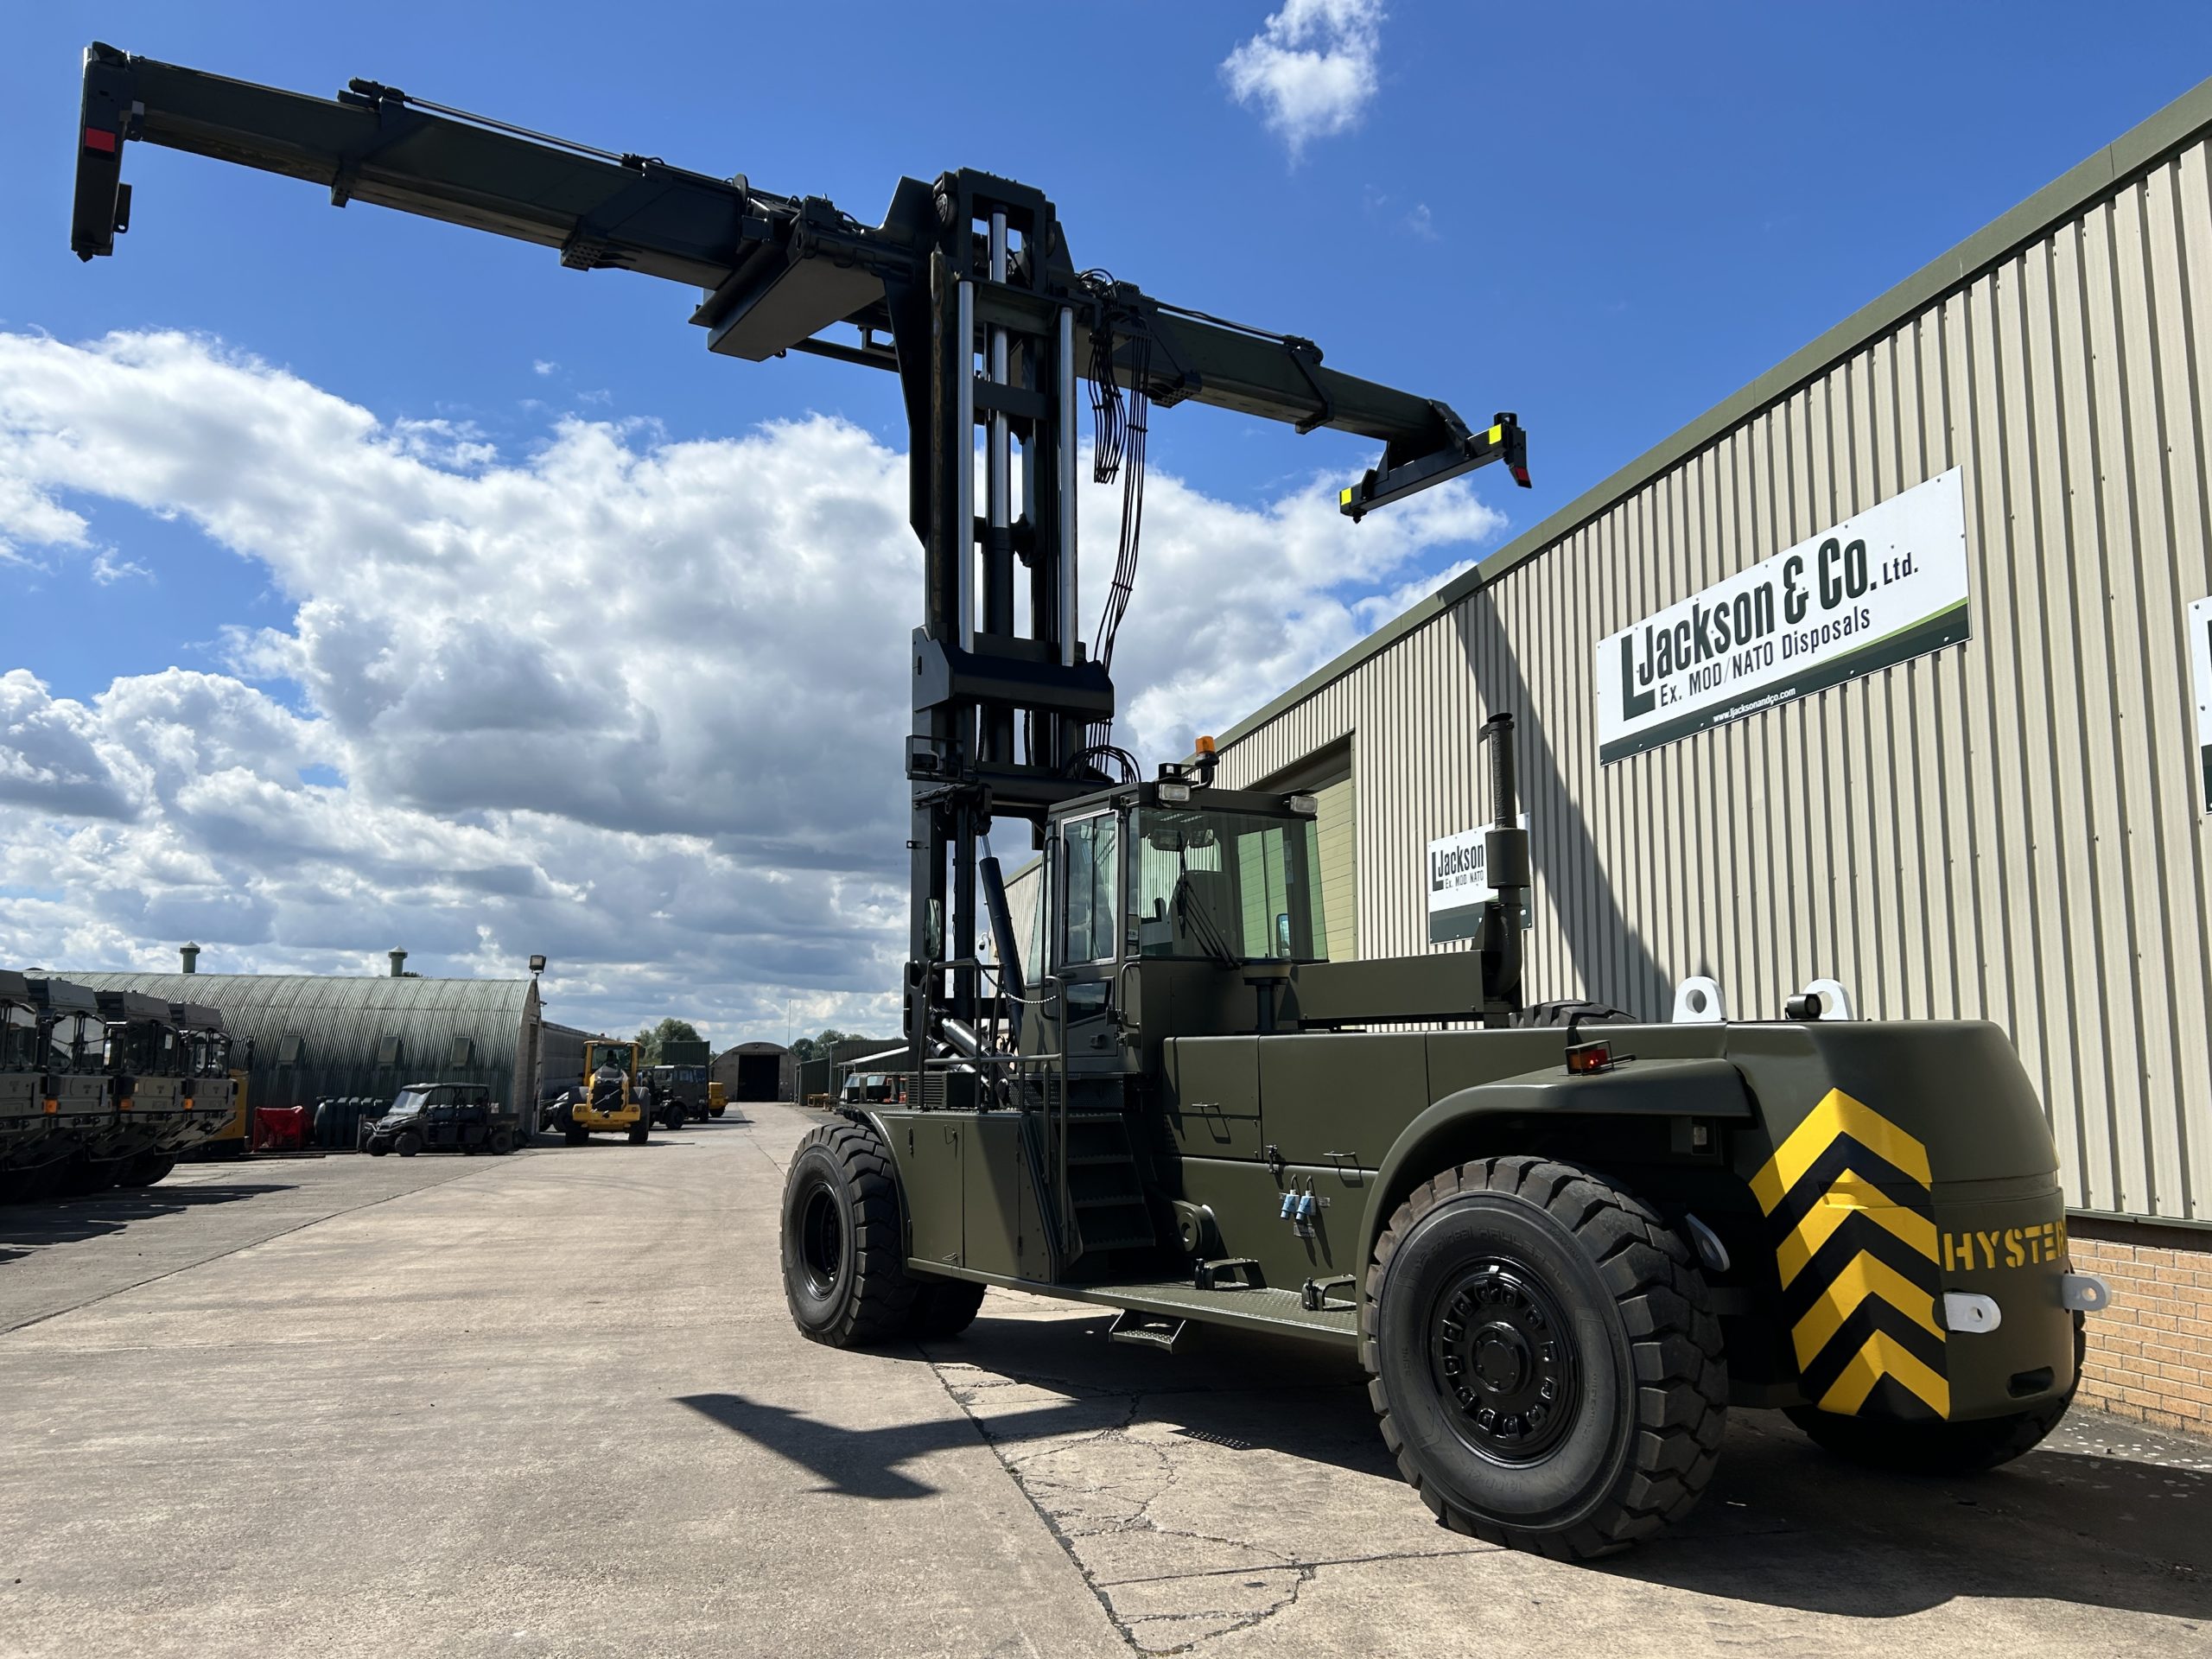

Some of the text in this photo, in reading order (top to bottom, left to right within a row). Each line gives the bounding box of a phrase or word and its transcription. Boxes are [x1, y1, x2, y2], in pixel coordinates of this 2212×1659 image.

[1783, 555, 1809, 625] &
[1818, 537, 1877, 610] Co.
[1883, 551, 1919, 586] Ltd.
[1660, 683, 1682, 707] Ex.
[1783, 606, 1871, 660] Disposals
[1470, 869, 1484, 883] NATO
[1942, 1220, 2067, 1272] HYSTER
